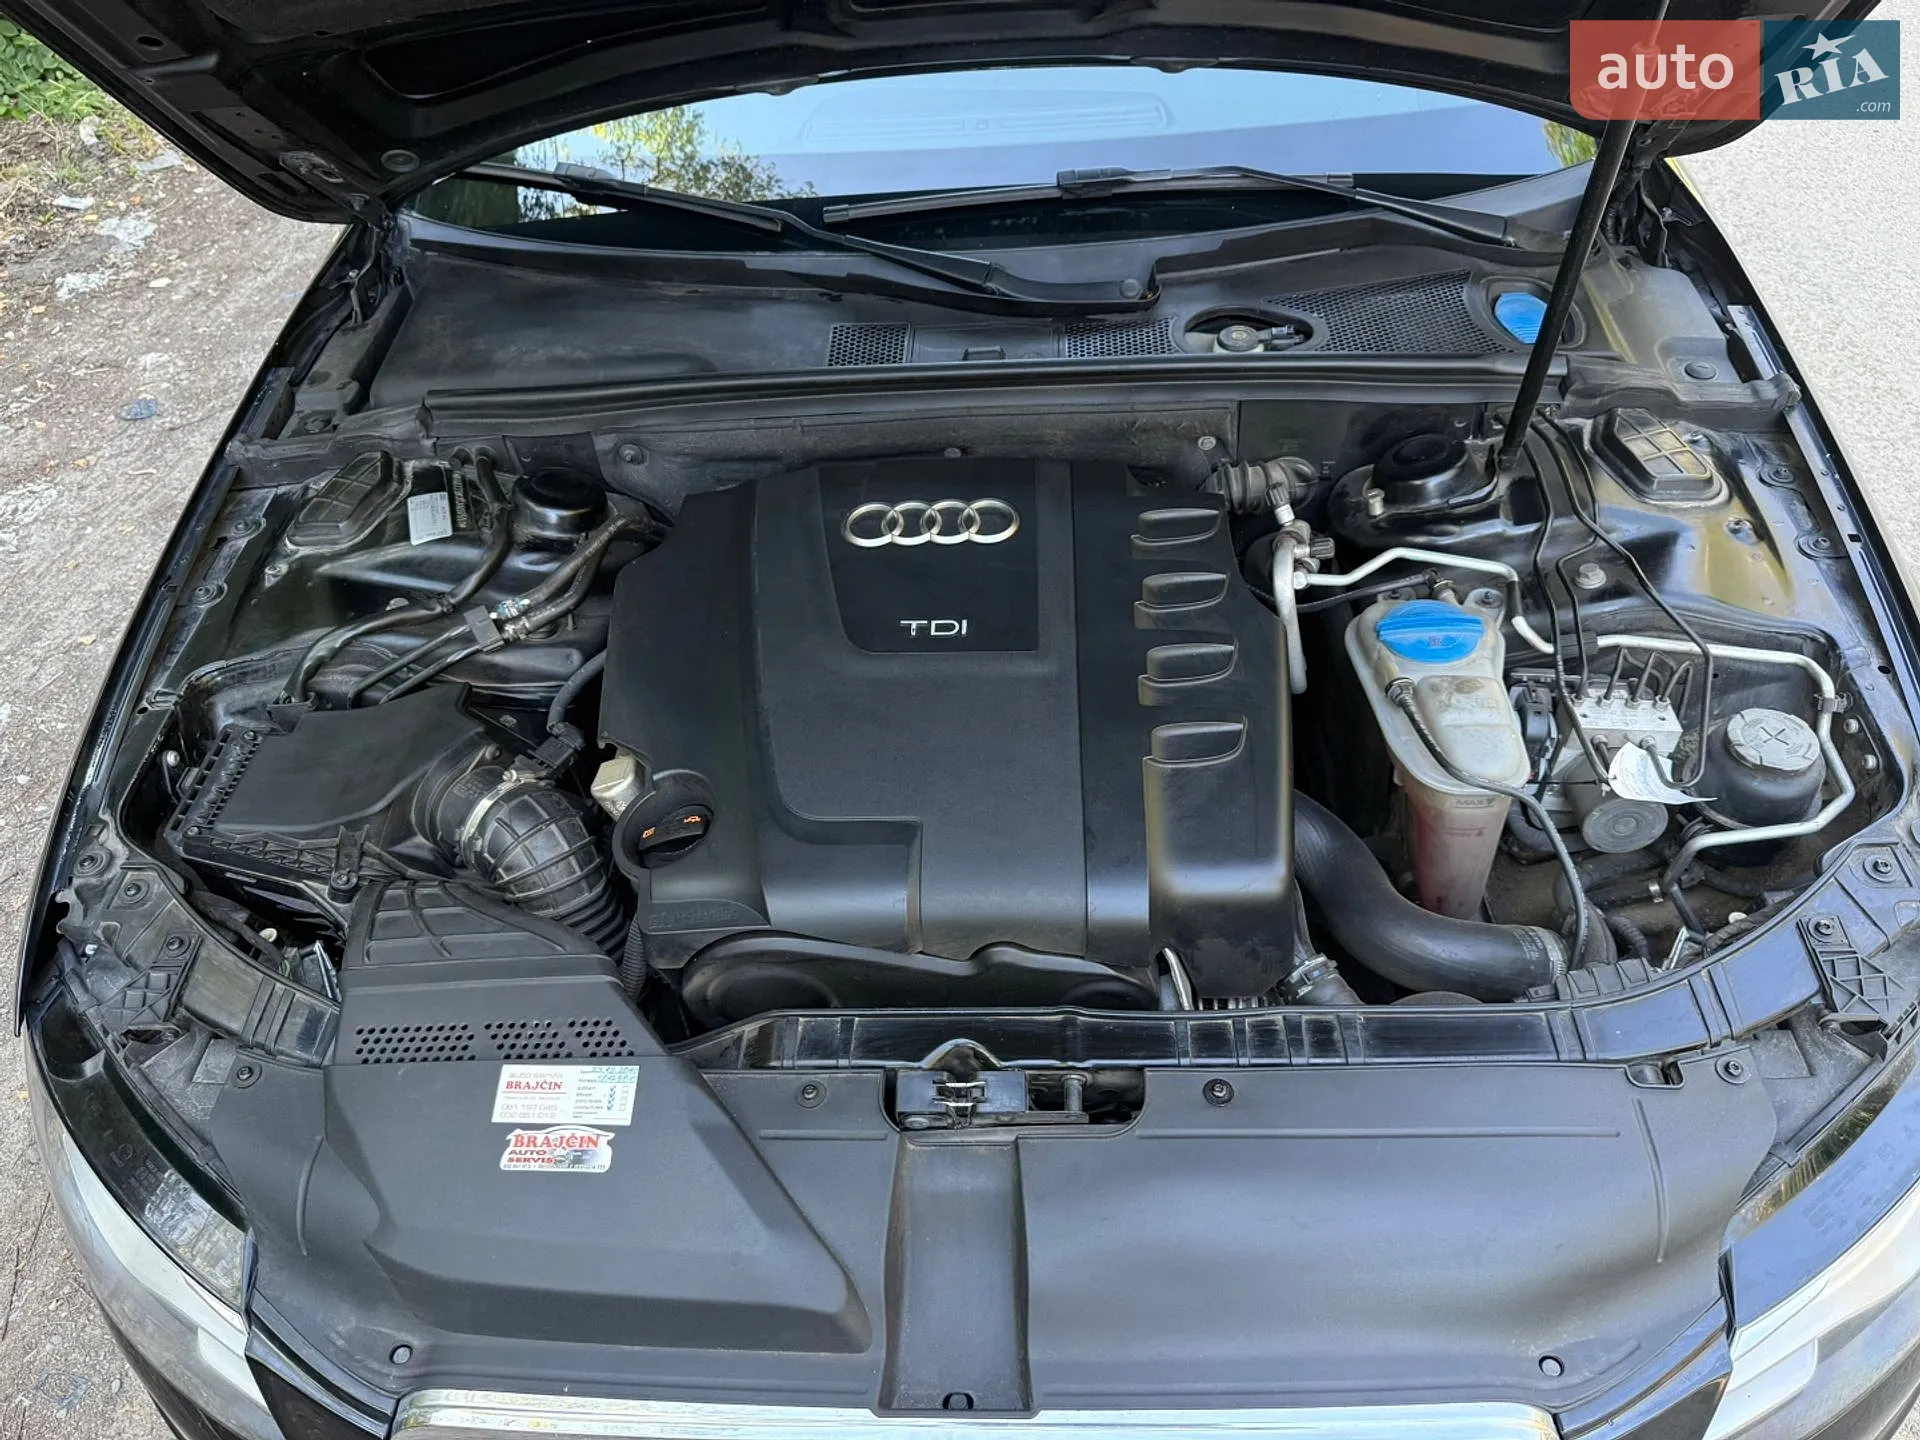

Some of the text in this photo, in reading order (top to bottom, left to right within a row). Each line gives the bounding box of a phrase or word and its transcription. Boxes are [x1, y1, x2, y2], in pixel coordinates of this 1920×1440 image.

[900, 619, 968, 636] TDI
[505, 1079, 564, 1091] BRAJČIN
[512, 1133, 601, 1149] BRAJČIN
